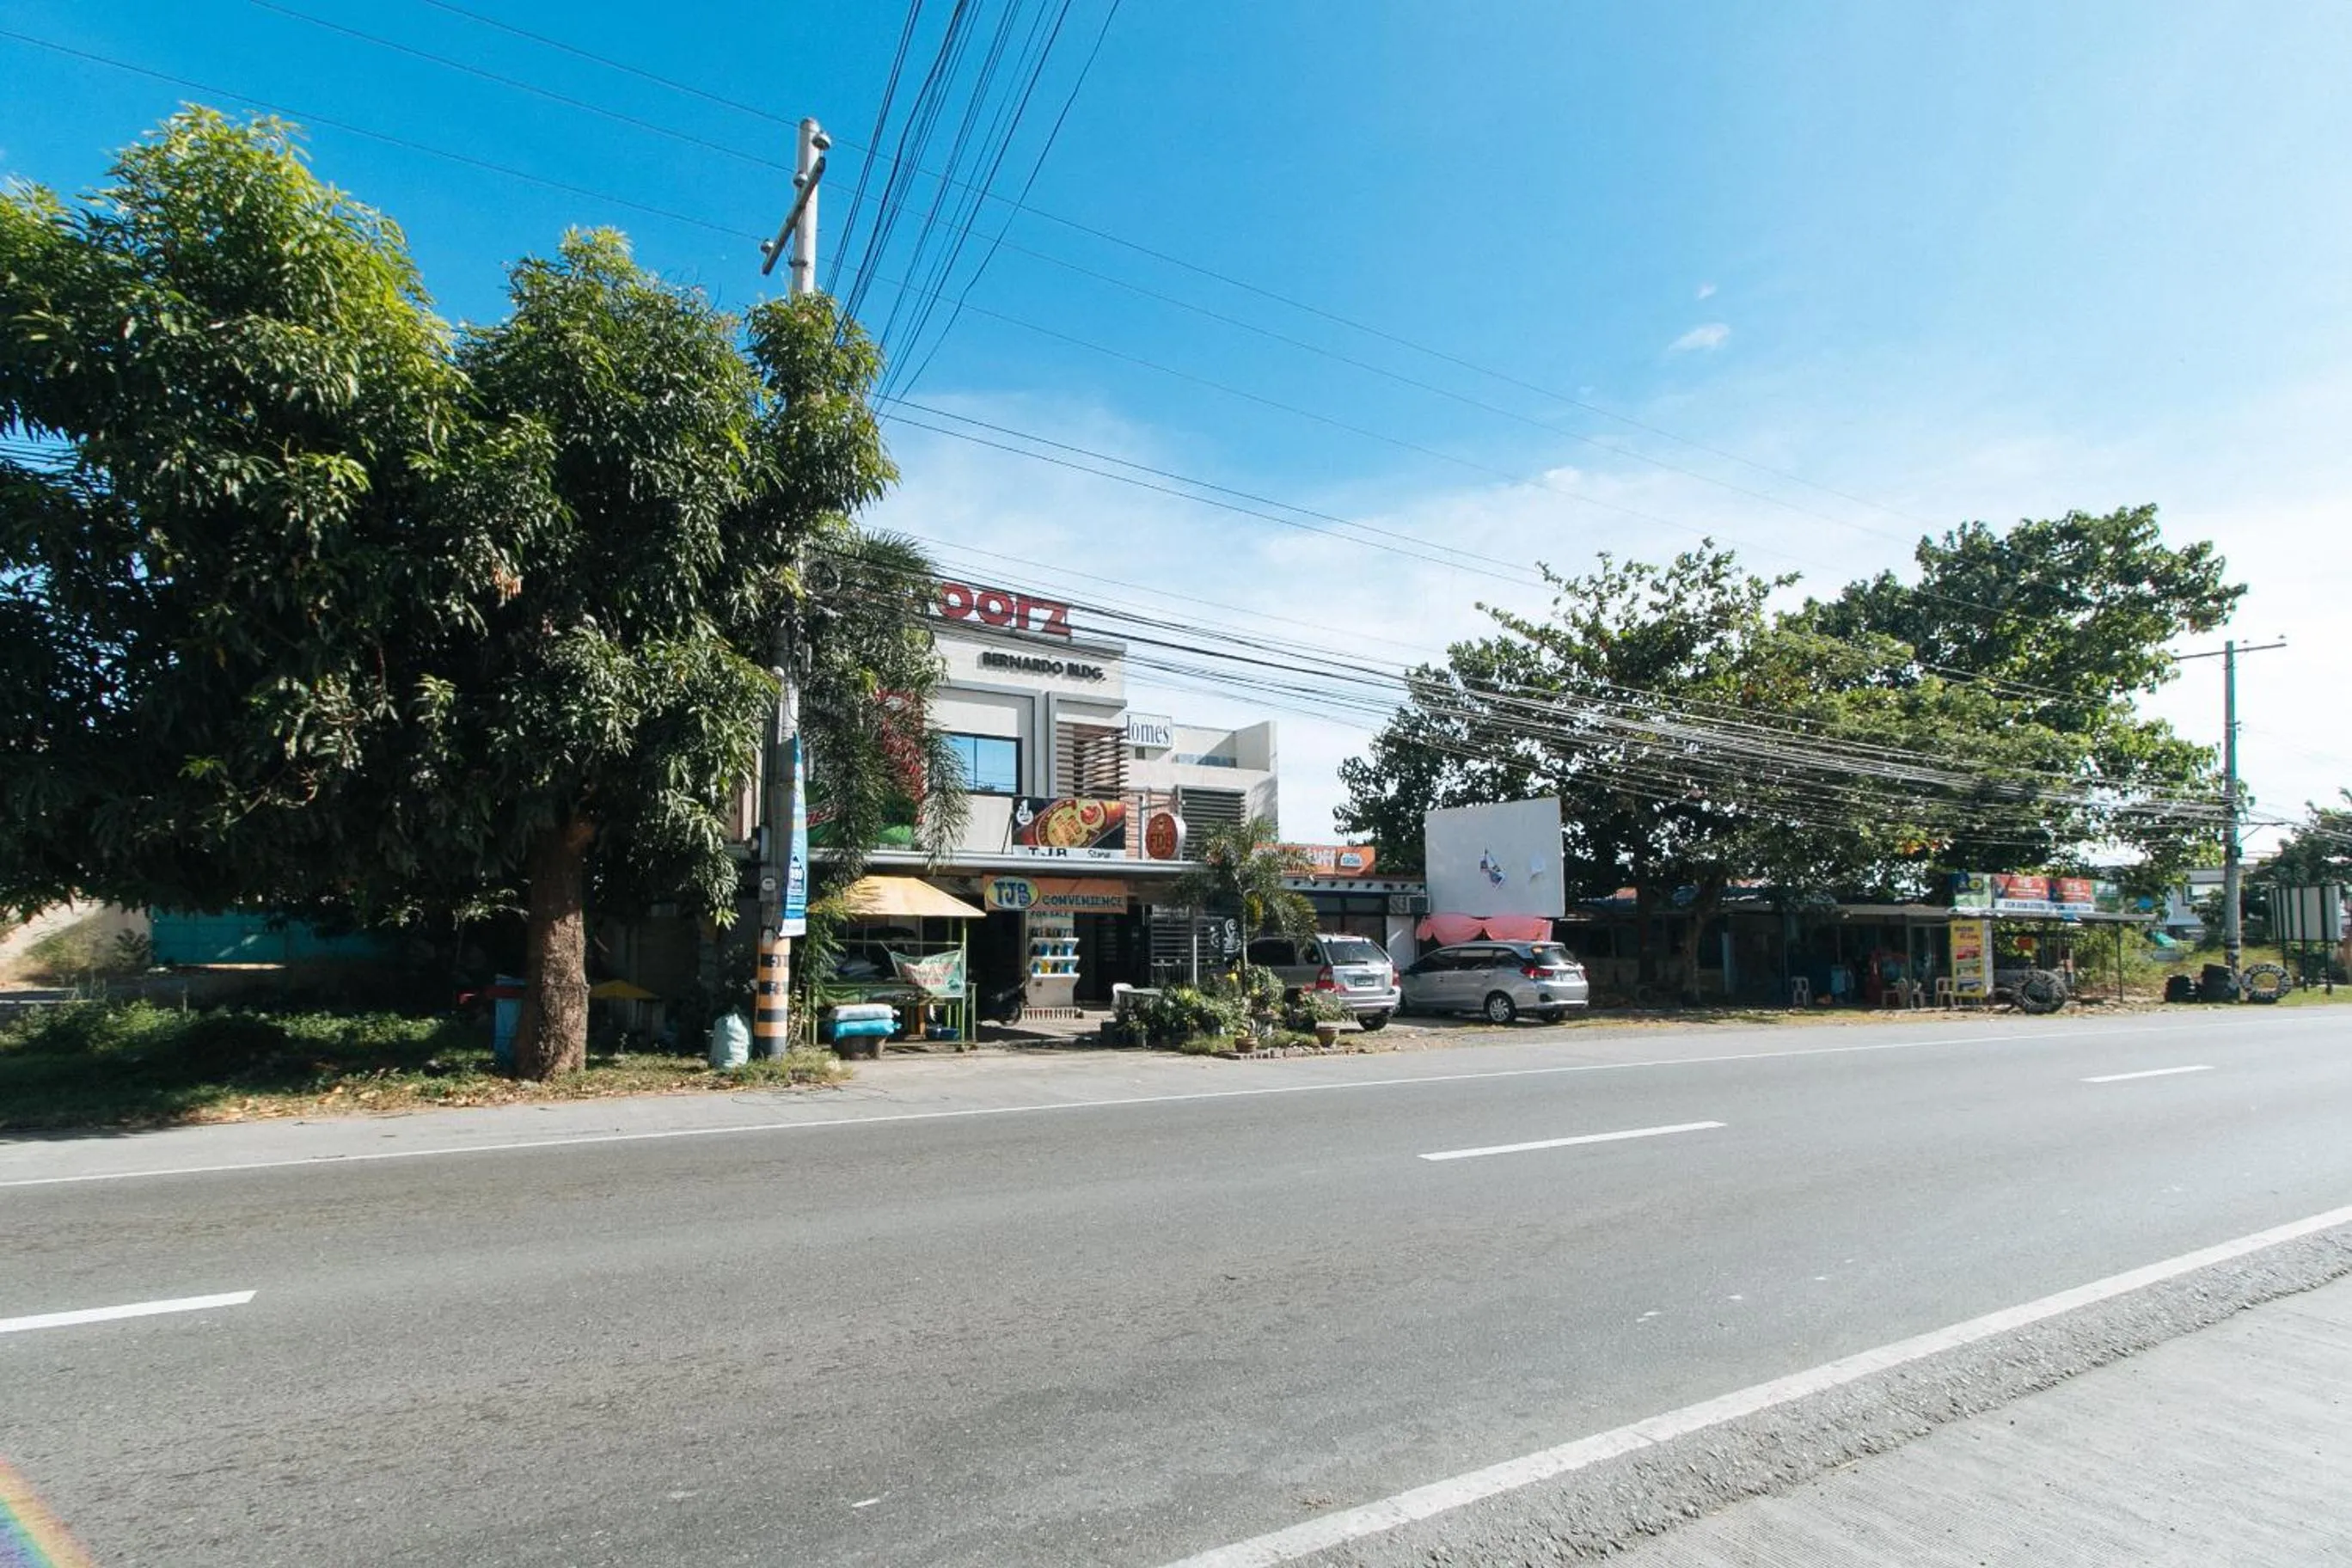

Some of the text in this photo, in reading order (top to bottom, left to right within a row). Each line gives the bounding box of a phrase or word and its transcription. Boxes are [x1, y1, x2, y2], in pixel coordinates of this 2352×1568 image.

[983, 652, 1063, 674] BERNARDO
[994, 881, 1032, 906] TJB
[1042, 895, 1123, 908] CONVENIENCE
